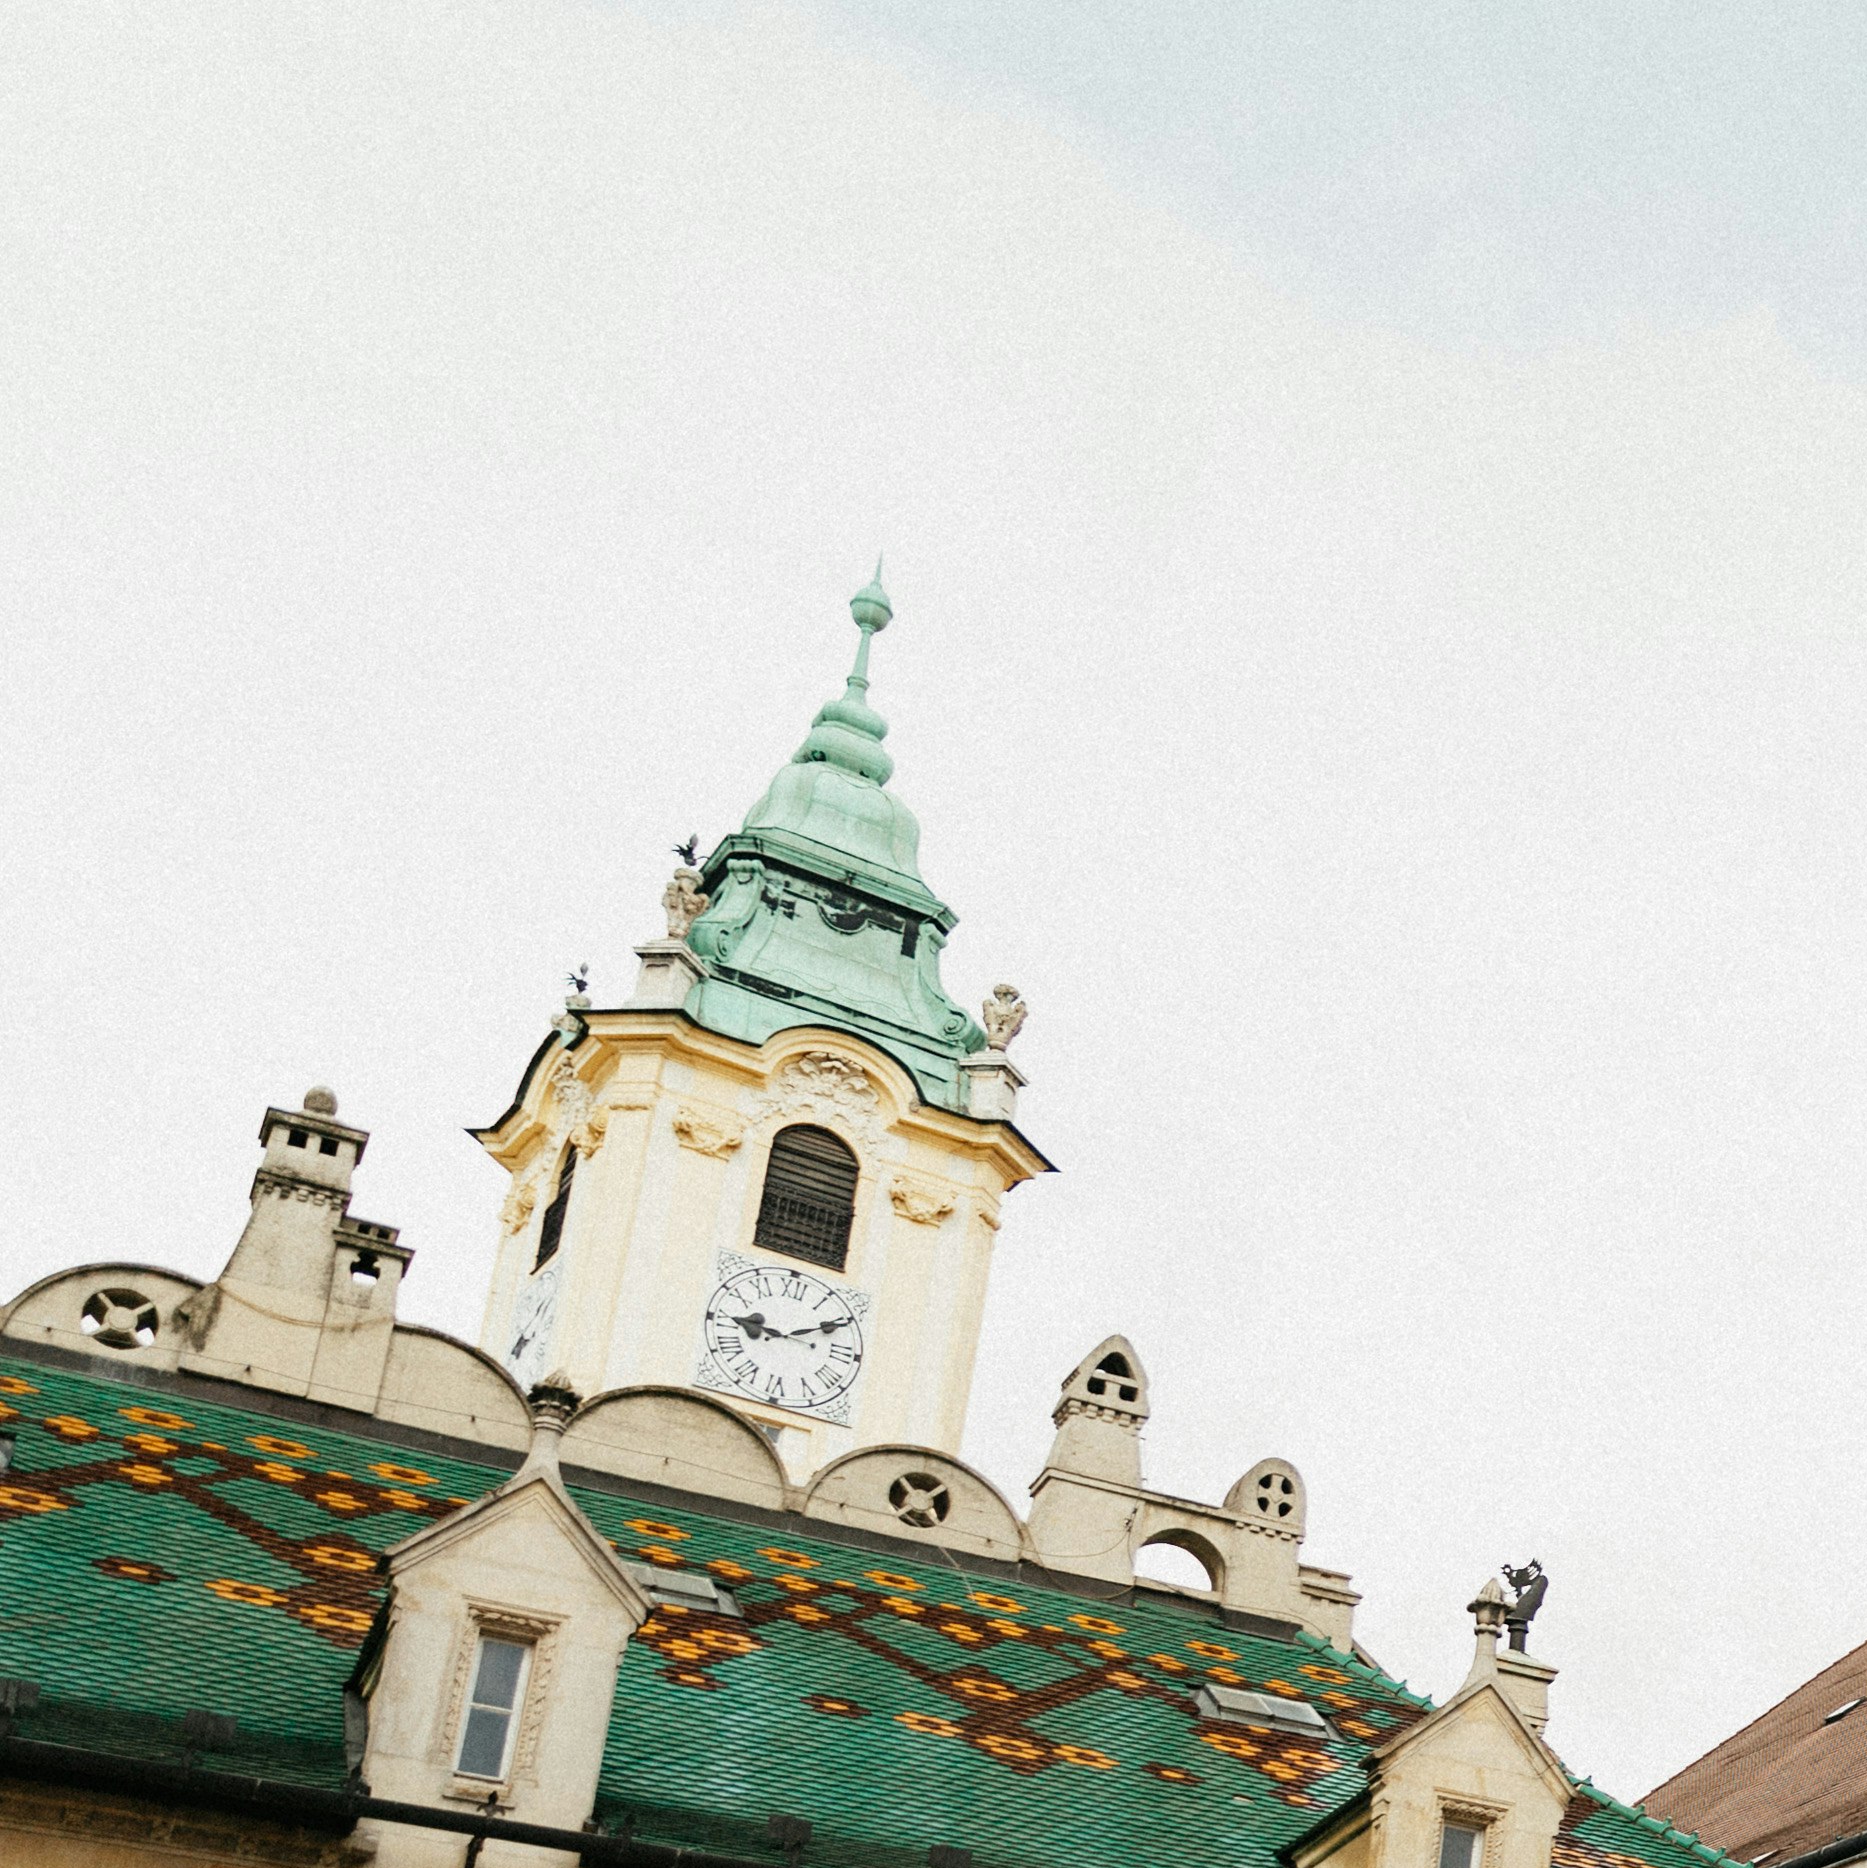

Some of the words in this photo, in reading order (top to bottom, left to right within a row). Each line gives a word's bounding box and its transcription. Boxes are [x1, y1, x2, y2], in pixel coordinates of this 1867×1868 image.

[729, 1288, 752, 1308] X
[749, 1277, 772, 1299] XI
[781, 1277, 808, 1301] XII
[812, 1297, 828, 1310] I
[717, 1336, 744, 1362] VIII
[829, 1343, 853, 1364] III
[735, 1359, 759, 1384] VII
[765, 1374, 785, 1397] VI
[801, 1377, 816, 1398] V
